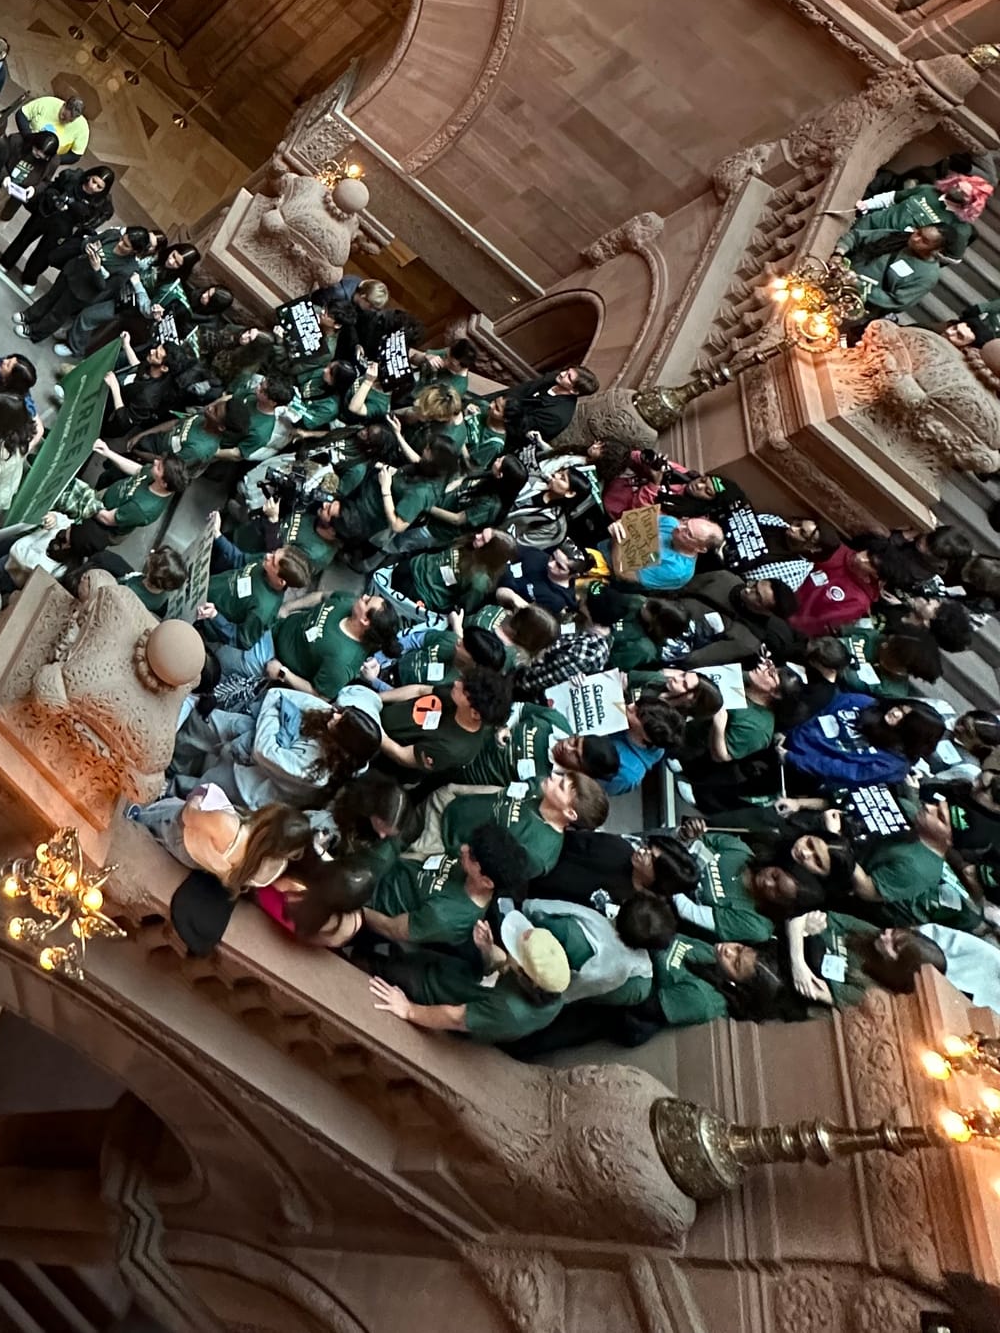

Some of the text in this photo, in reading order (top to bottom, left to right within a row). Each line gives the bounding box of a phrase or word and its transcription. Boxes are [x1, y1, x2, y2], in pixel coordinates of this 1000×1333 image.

[732, 511, 745, 533] JUSTICE
[747, 513, 761, 537] SUPPORT
[757, 537, 766, 548] THE
[737, 542, 746, 559] YORK
